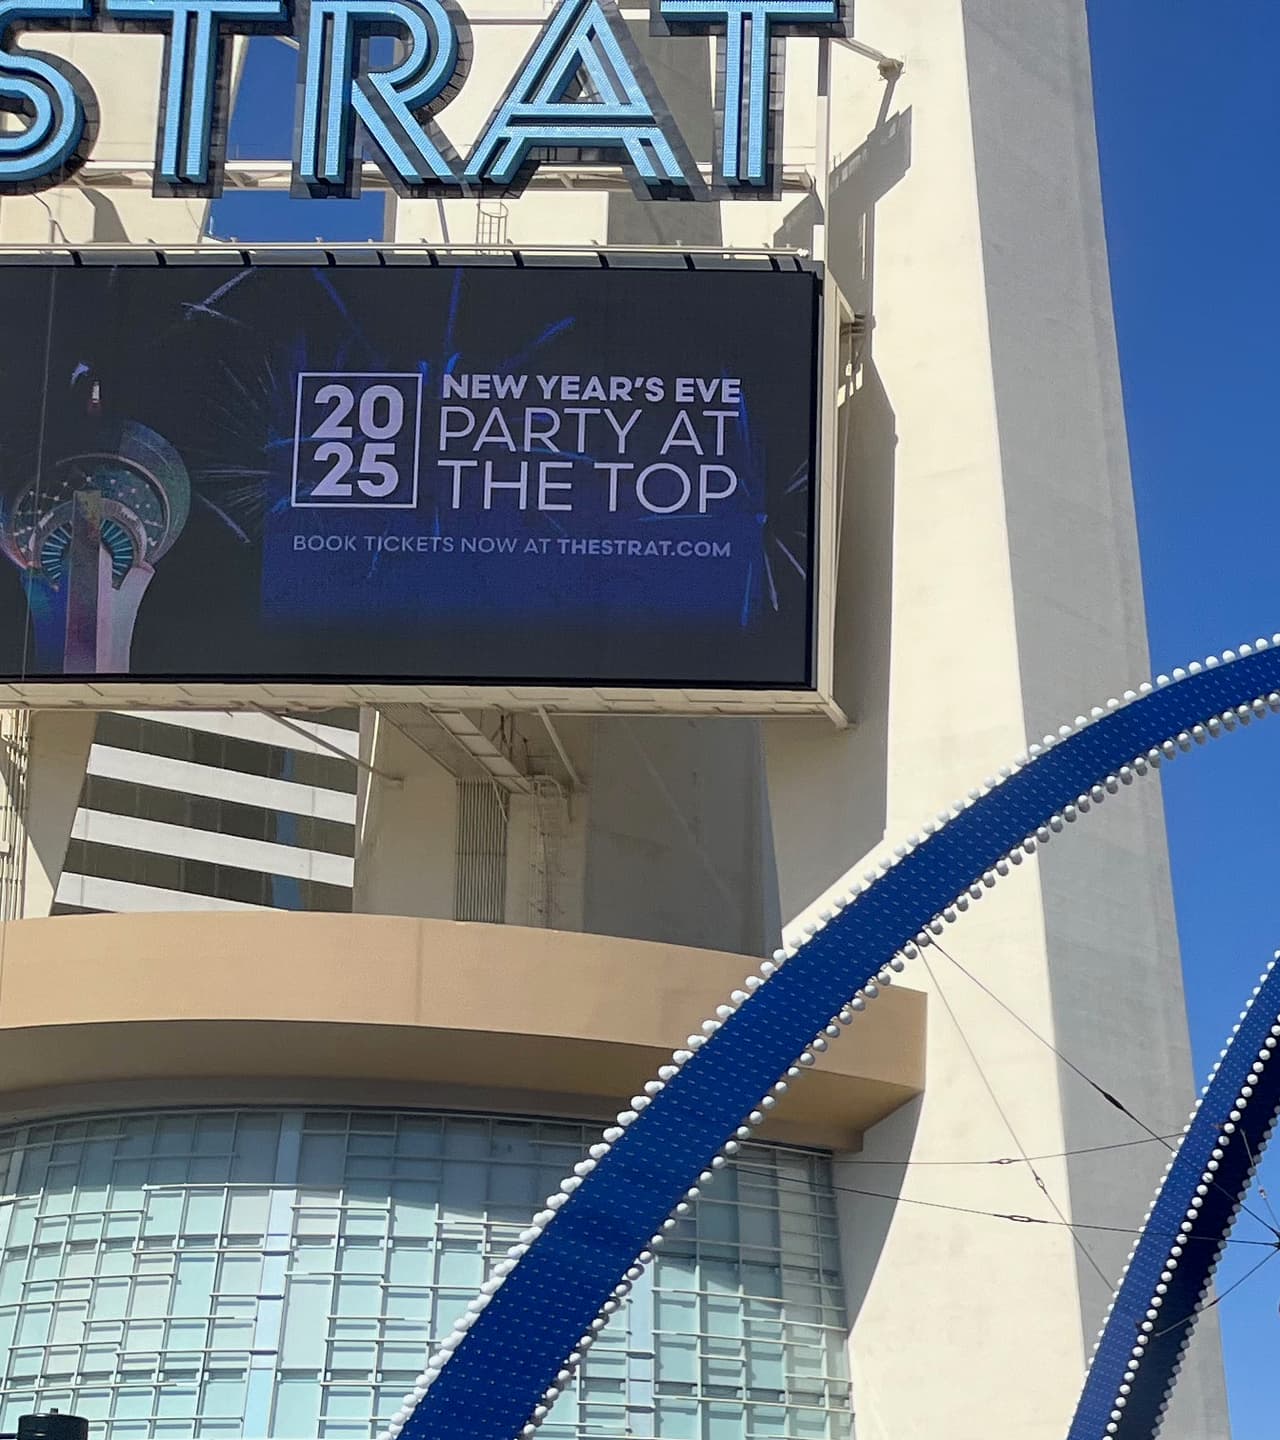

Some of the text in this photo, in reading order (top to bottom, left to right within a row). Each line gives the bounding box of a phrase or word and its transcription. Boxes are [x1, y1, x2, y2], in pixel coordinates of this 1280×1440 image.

[0, 0, 848, 192] STRAT
[310, 384, 404, 440] 20
[442, 374, 741, 403] NEW YEAR'S EVE
[439, 406, 739, 456] PARTY AT
[310, 442, 400, 497] 25
[437, 460, 738, 514] THE TOP
[293, 535, 731, 557] BOOK TICKETS NOW AT THESTRAT.COM
